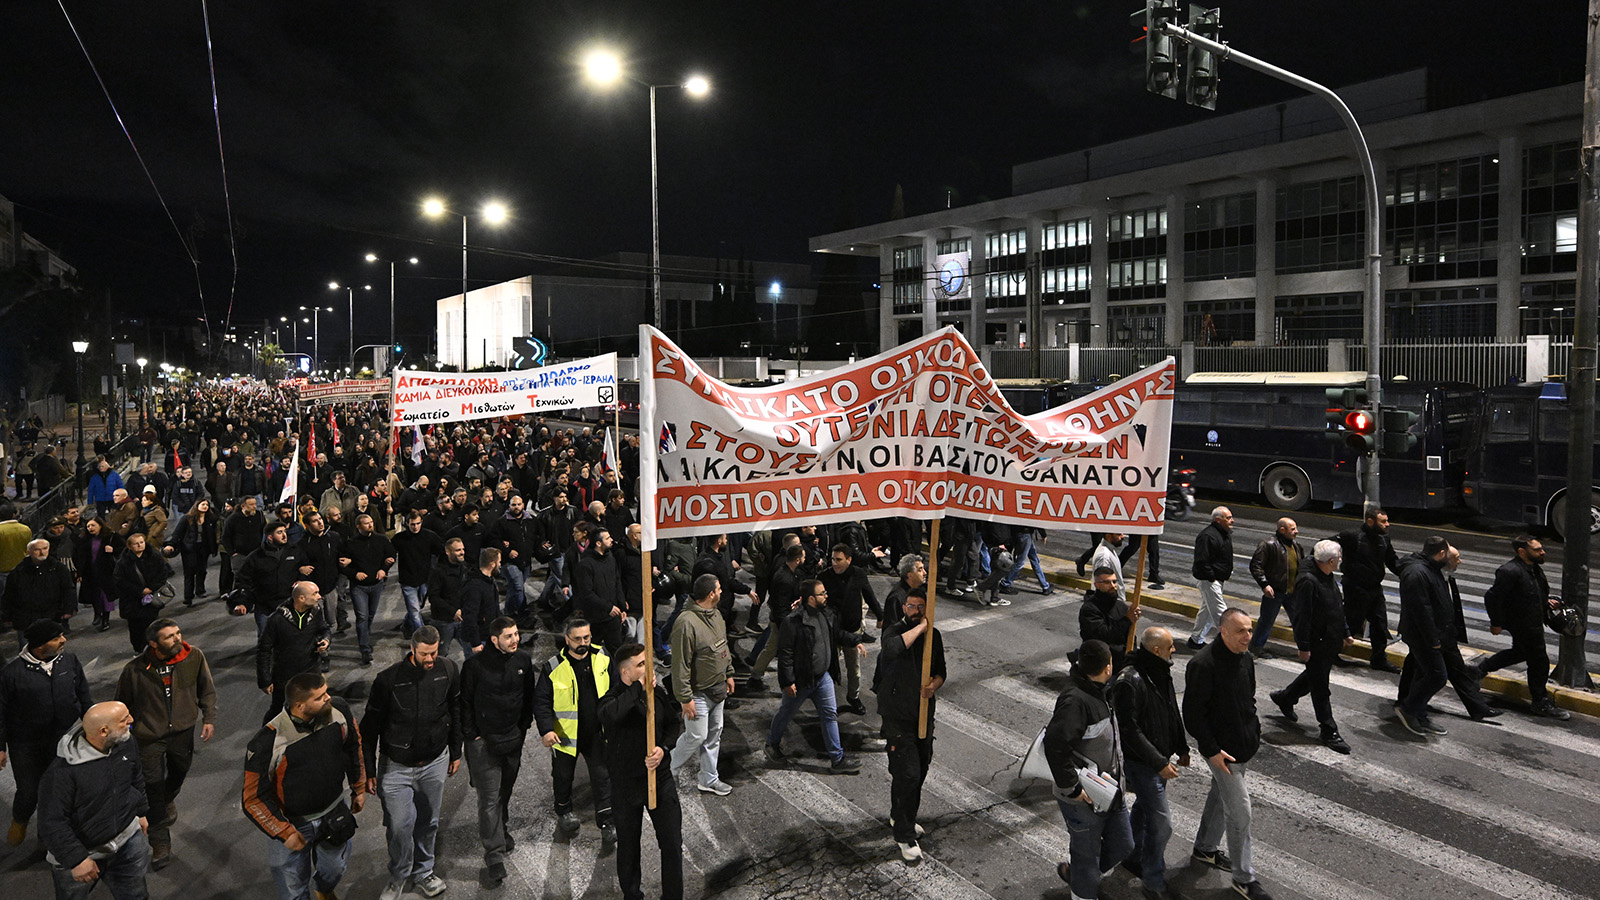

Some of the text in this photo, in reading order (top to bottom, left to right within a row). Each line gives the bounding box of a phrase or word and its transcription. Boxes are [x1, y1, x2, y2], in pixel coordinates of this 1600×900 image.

[394, 408, 450, 423] Σωματείο
[526, 394, 574, 408] Τεχνικών
[395, 391, 431, 405] ΚΑΜΙΑ
[436, 385, 507, 400] ΔΙΕΥΚΟΛΥΝΣΗ
[869, 444, 901, 468] ΟΙ
[972, 450, 1016, 478] ΤΟΥ
[1020, 463, 1163, 488] ΘΑΝΑΤΟΥ
[657, 482, 868, 524] ΜΟΣΠΟΝΔΙΑ
